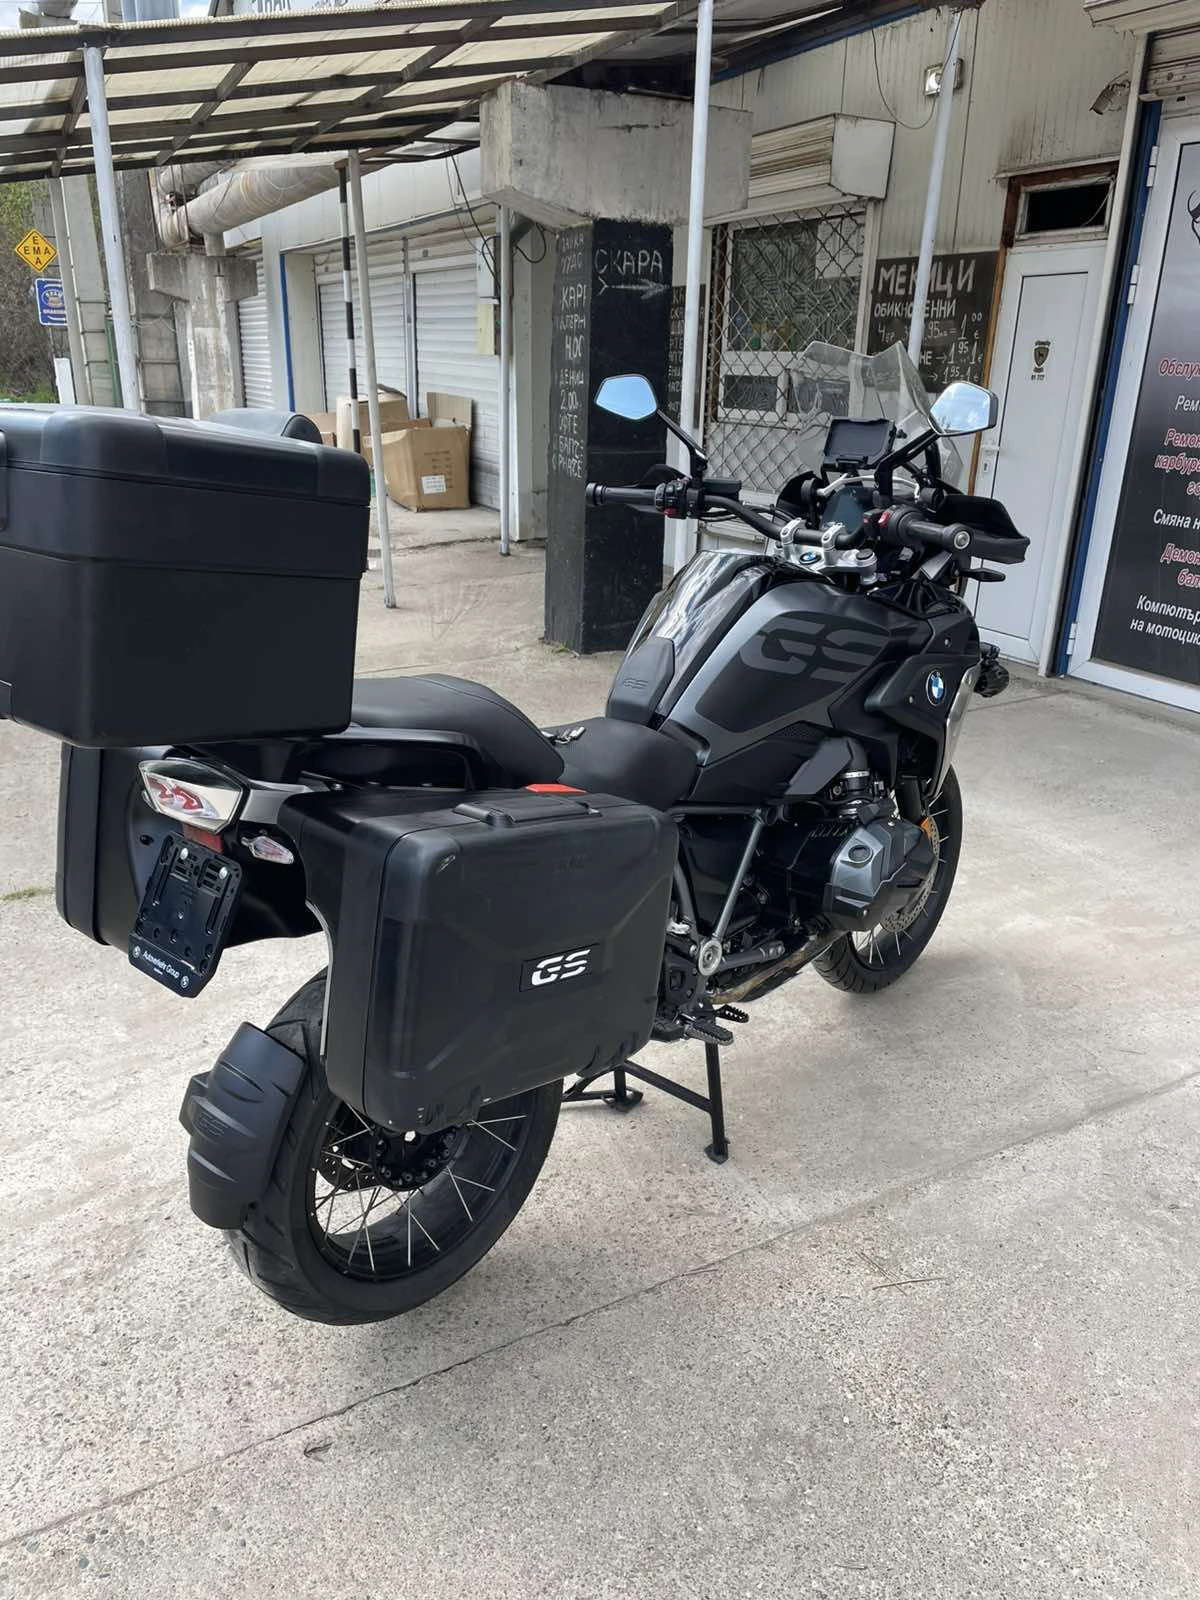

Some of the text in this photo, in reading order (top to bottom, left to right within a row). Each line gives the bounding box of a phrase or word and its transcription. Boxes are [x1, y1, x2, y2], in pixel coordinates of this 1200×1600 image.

[594, 248, 663, 276] СКАРА
[873, 298, 957, 320] ОБИКНОЕННИ
[1174, 395, 1200, 413] Рем
[1153, 508, 1191, 529] Смяна
[1129, 618, 1145, 631] на
[740, 616, 890, 683] GS
[531, 949, 591, 986] GS
